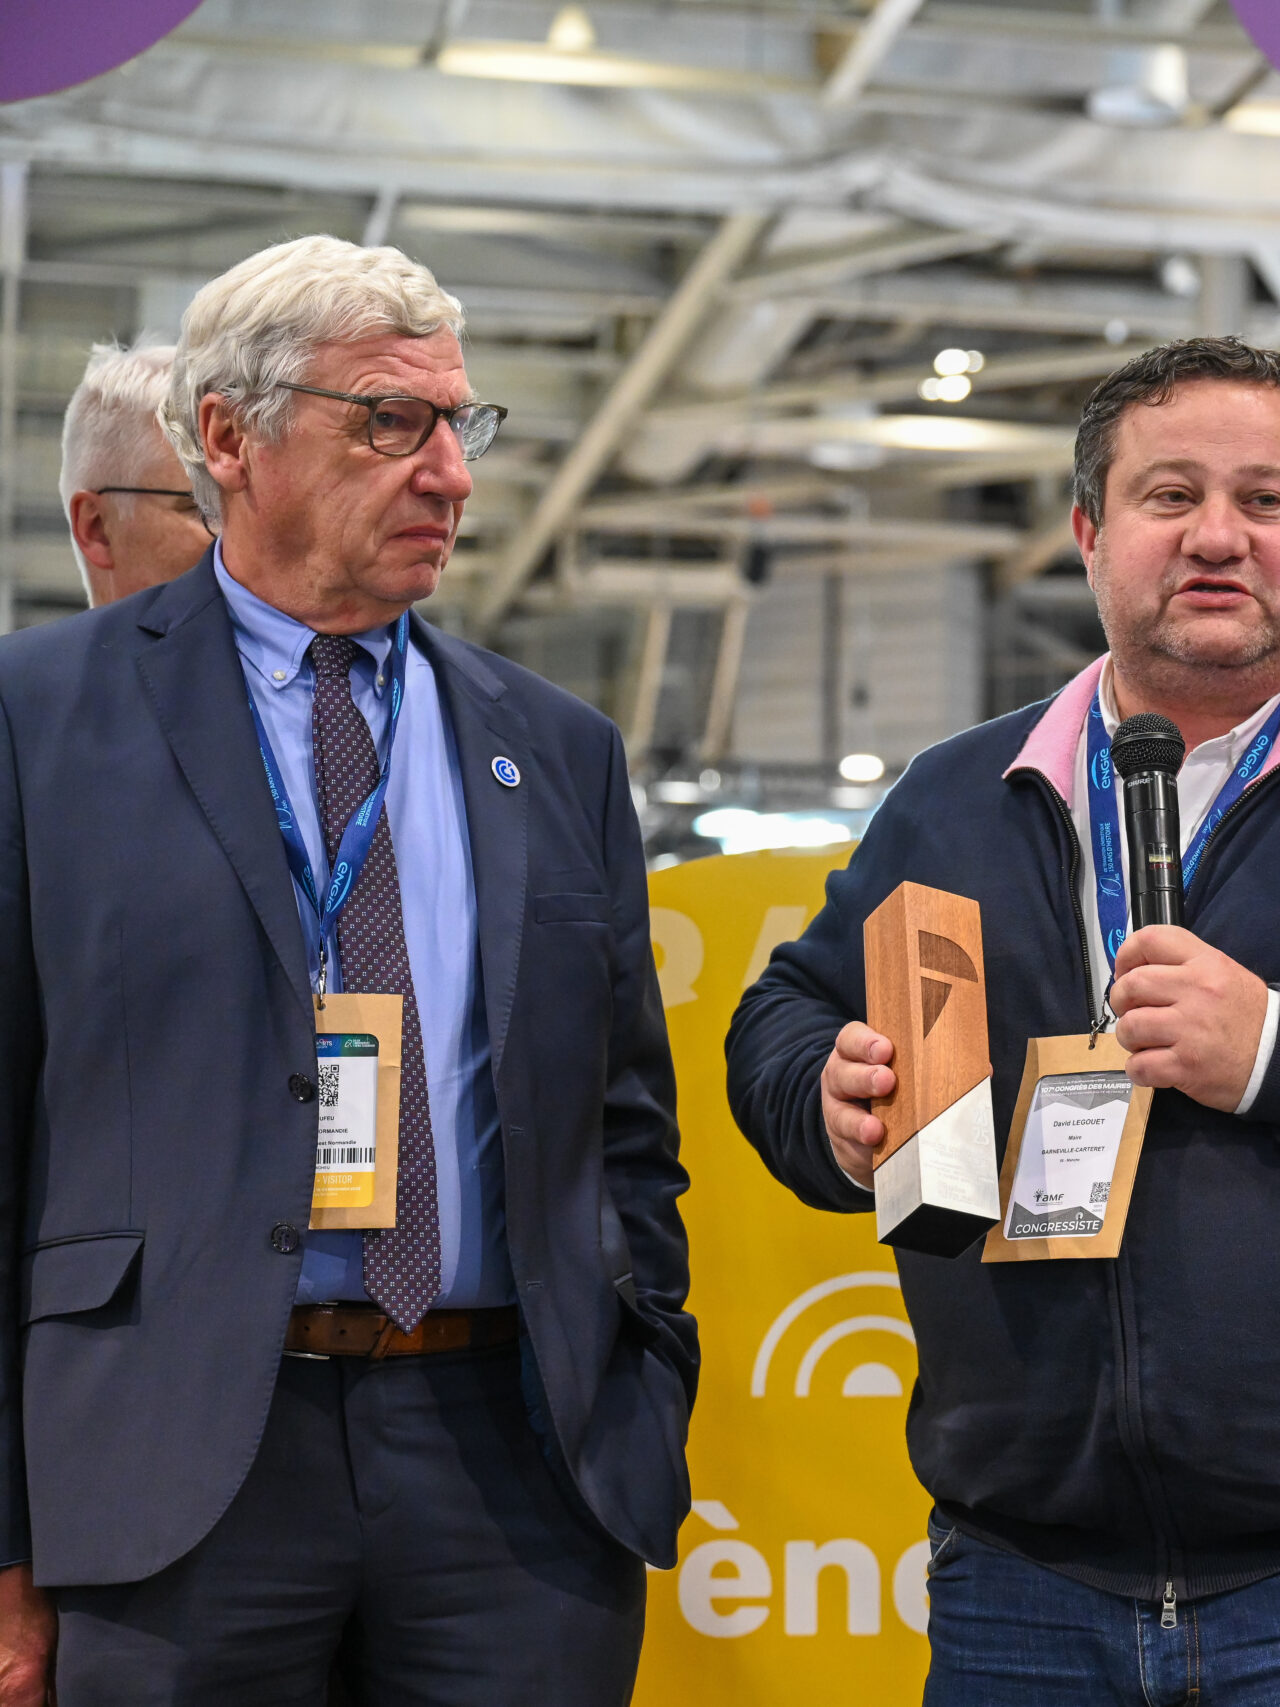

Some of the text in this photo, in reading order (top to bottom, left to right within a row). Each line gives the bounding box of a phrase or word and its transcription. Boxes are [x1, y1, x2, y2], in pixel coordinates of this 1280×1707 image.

[1072, 1118, 1106, 1126] LEGOUET
[1041, 1146, 1105, 1155] BARNEVILLE-CARTERET
[322, 1175, 353, 1184] VISITOR
[1015, 1220, 1100, 1234] CONGRESSISTE
